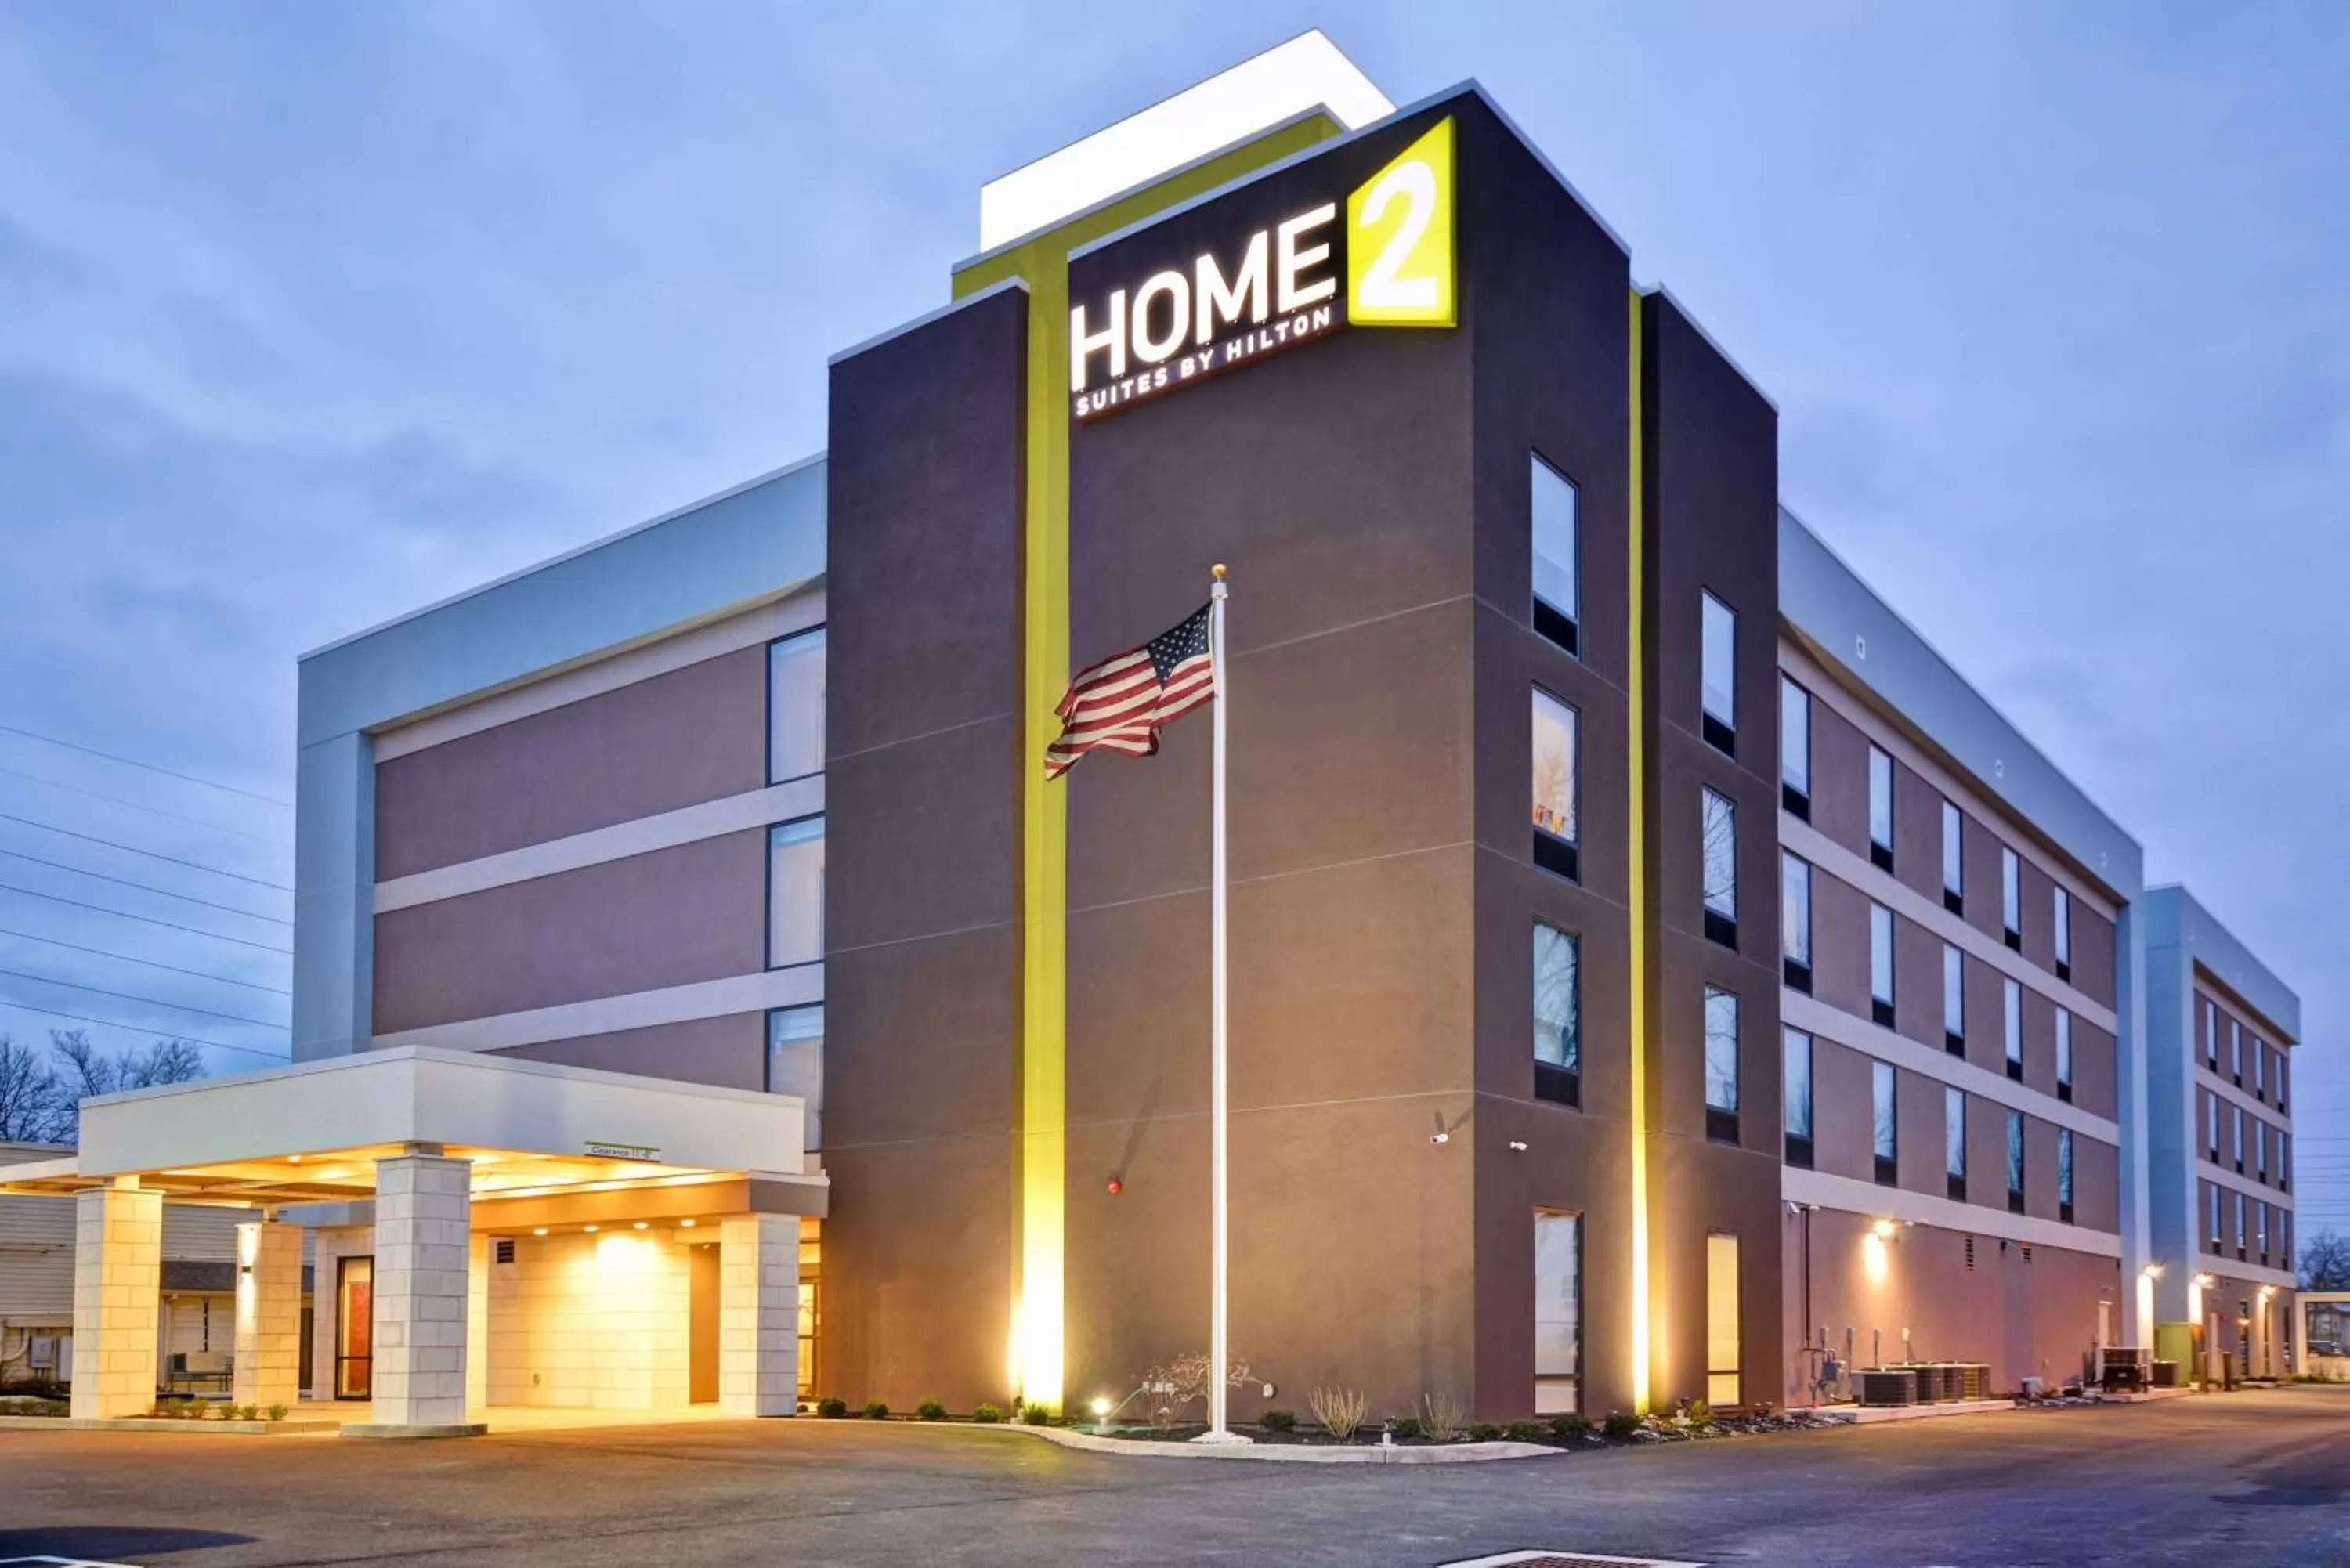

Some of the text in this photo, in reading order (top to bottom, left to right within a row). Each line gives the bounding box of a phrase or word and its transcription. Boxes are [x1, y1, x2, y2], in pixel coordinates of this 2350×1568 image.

[1070, 160, 1438, 392] HOME 2
[1076, 306, 1331, 417] SUITES BY HILTON
